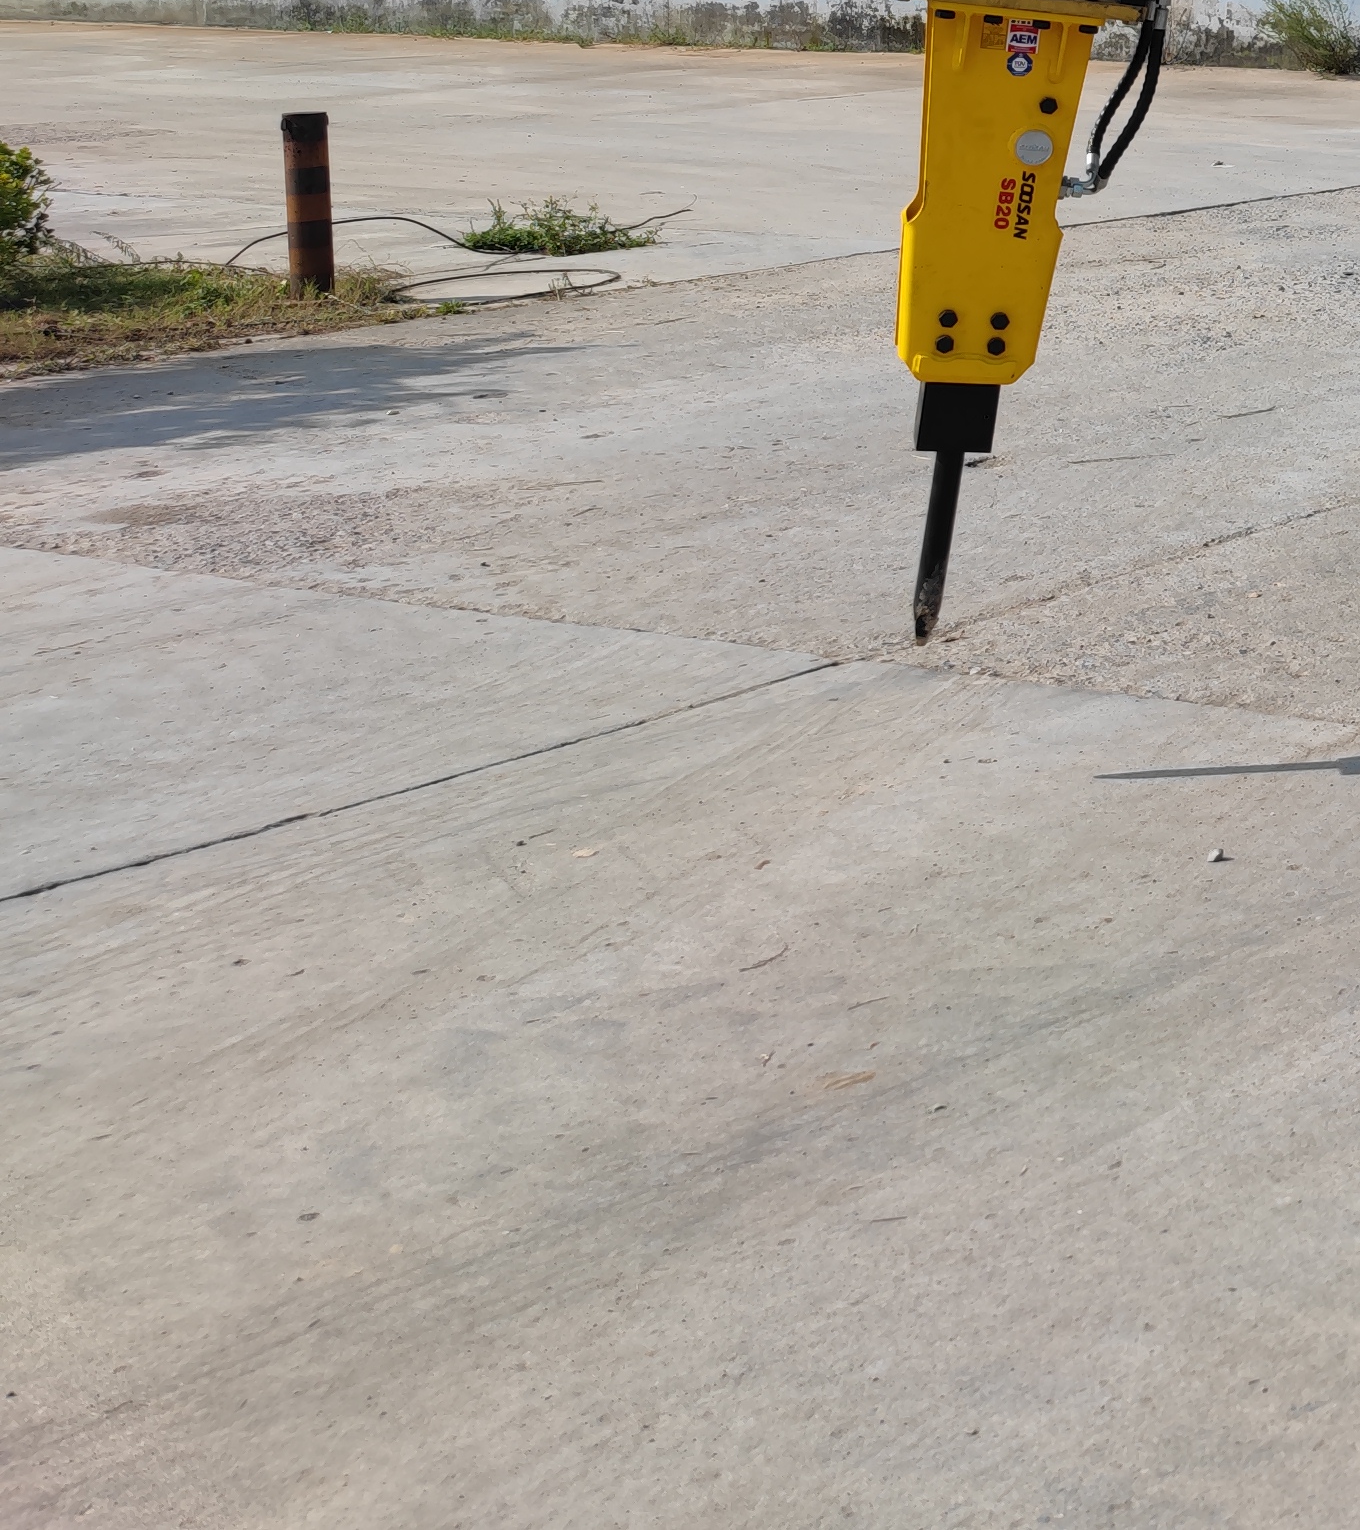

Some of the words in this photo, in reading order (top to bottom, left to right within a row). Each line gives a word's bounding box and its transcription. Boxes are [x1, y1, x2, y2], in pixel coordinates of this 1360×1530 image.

[1010, 33, 1038, 46] AEM
[994, 177, 1017, 230] SB20
[1013, 171, 1036, 240] SOOSAN
